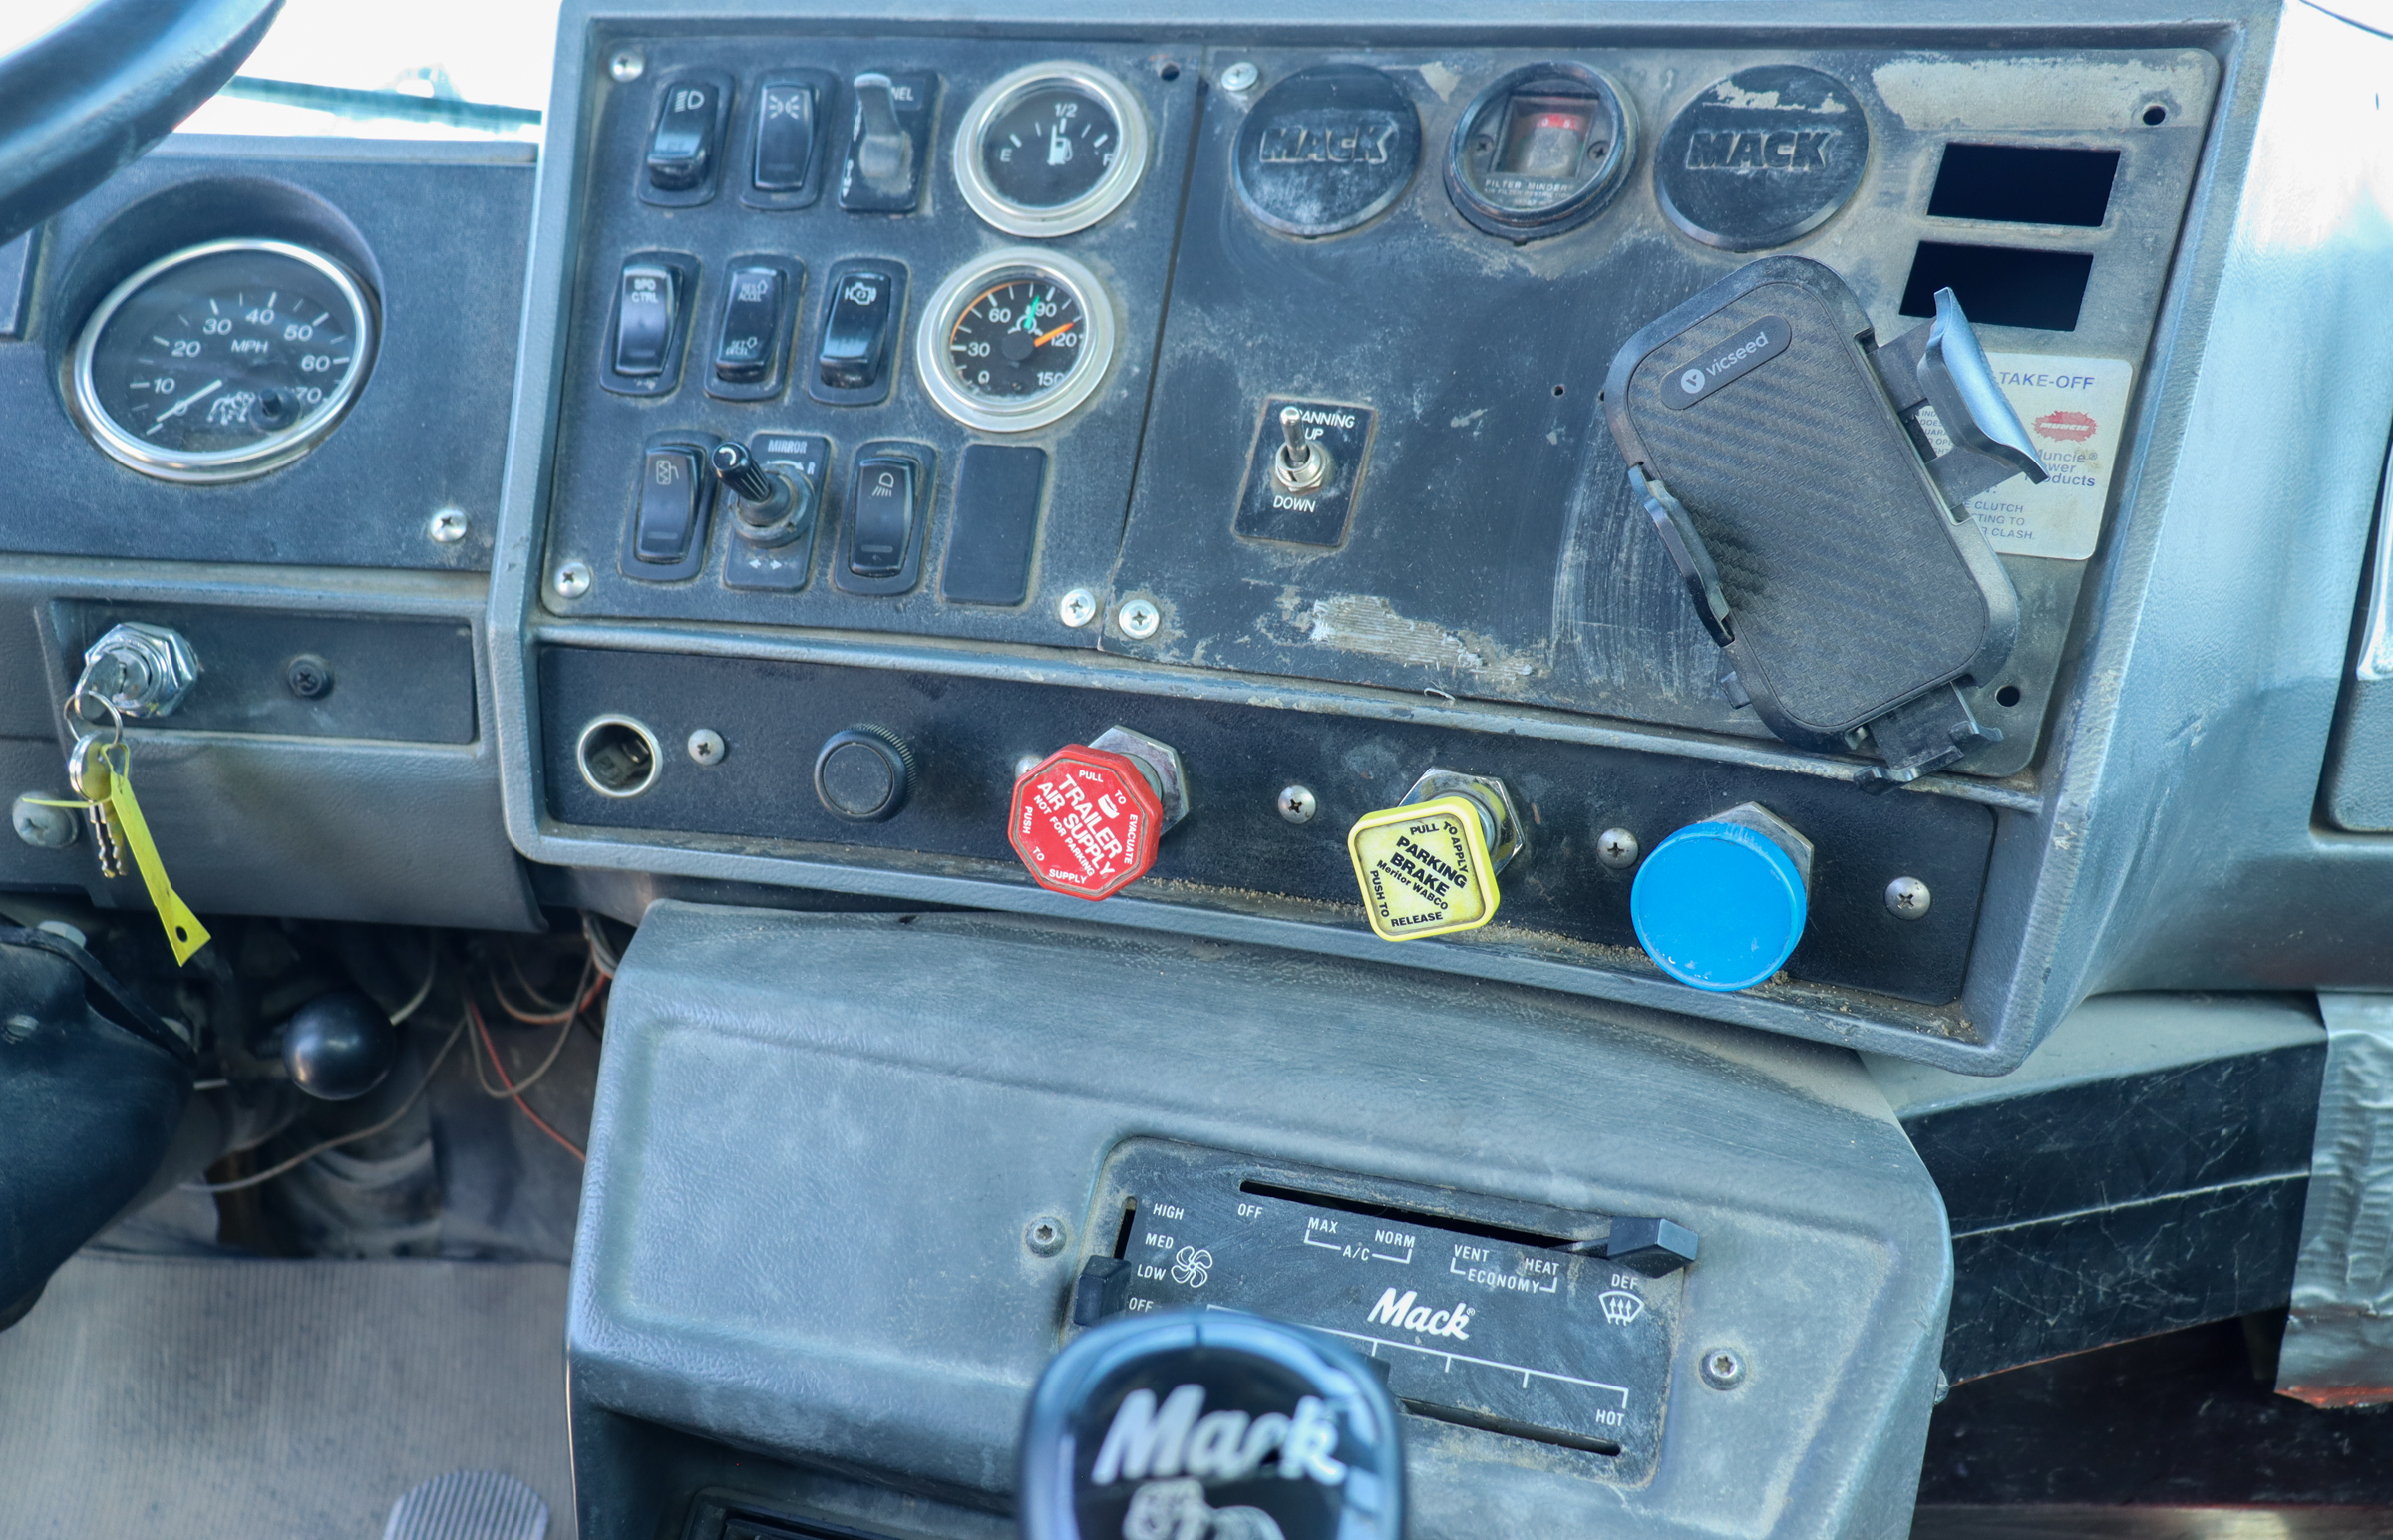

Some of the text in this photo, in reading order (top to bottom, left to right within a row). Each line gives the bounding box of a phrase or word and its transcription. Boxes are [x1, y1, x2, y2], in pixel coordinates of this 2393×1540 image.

[890, 86, 914, 102] NEL
[1054, 103, 1078, 118] 1/2
[1259, 126, 1393, 164] MACK
[1686, 131, 1832, 169] MACK
[999, 148, 1012, 162] E
[1102, 153, 1114, 167] F
[1485, 179, 1522, 190] FILTER
[631, 291, 659, 303] CTRL
[737, 292, 762, 302] ACCEL
[245, 308, 274, 325] 40
[988, 307, 1012, 324] 60
[1035, 303, 1057, 317] 90
[202, 318, 232, 335] 30
[283, 325, 313, 341] 50
[230, 339, 268, 353] MPH
[1050, 333, 1078, 347] 120
[171, 341, 201, 357] 20
[967, 342, 991, 357] 30
[1705, 331, 1769, 377] vicseed
[300, 355, 330, 372] 60
[153, 377, 175, 394] 10
[977, 370, 990, 385] 0
[1036, 371, 1065, 386] 150
[1998, 371, 2095, 390] TAKE-OFF
[295, 386, 322, 404] 70
[1299, 409, 1355, 429] ANNING
[2039, 422, 2090, 432] MUNCIE
[1304, 427, 1324, 441] UP
[767, 439, 808, 454] MIRROR
[807, 462, 816, 475] R
[1273, 495, 1316, 513] DOWN
[1974, 500, 2024, 513] CLUTCH
[2009, 516, 2026, 526] TO
[1991, 527, 2035, 539] CLASH.
[1058, 773, 1123, 860] TRAILER
[1079, 769, 1139, 865] PULL TO EVACUATE
[1033, 794, 1096, 877] NOT FOR PARKING
[1037, 781, 1116, 876] AIR SUPPLY
[1022, 805, 1088, 885] PUSH TO SUPPLY
[1409, 820, 1469, 874] PULL TO APPLY
[1396, 835, 1468, 889] PARKING
[1389, 852, 1450, 897] BRAKE
[1376, 859, 1449, 910] Meritor WABCO
[1370, 870, 1444, 928] PUSH TO RELEASE
[1153, 1202, 1186, 1221] HIGH
[1236, 1202, 1264, 1219] OFF
[1307, 1216, 1339, 1235] MAX
[1145, 1232, 1175, 1250] MED
[1374, 1228, 1416, 1249] NORM
[1342, 1244, 1371, 1263] A/C
[1453, 1243, 1491, 1264] VENT
[1136, 1263, 1167, 1281] LOW
[1524, 1257, 1560, 1277] HEAT
[1467, 1268, 1541, 1295] ECONOMY
[1610, 1273, 1639, 1291] DEF
[1128, 1297, 1154, 1313] OFF
[1595, 1408, 1625, 1428] HOT
